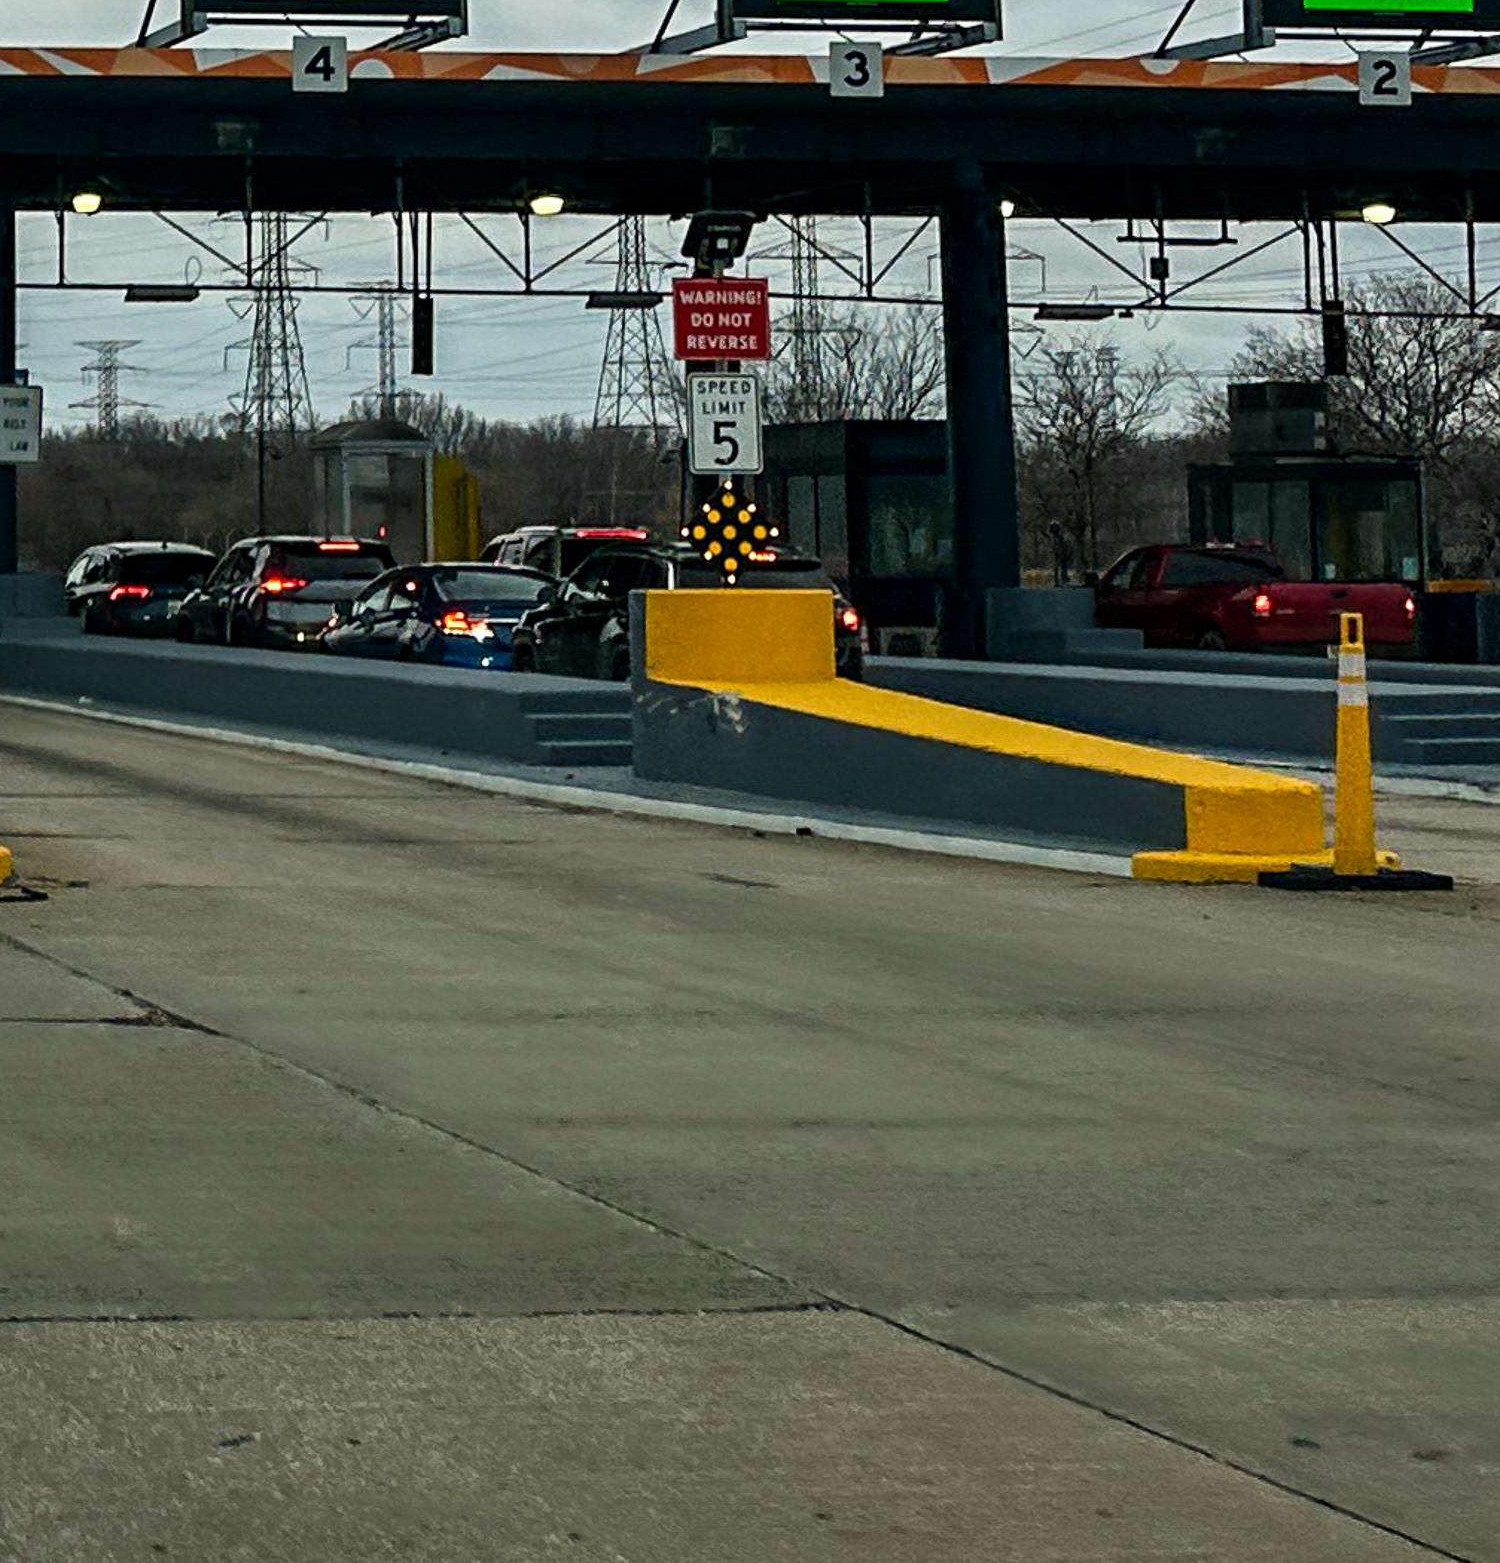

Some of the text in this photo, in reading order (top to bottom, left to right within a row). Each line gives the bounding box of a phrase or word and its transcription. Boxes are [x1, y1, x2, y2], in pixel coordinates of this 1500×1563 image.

[303, 45, 336, 82] 4
[843, 50, 870, 87] 3
[1371, 59, 1398, 96] 2
[679, 289, 762, 306] WARNING!
[690, 312, 753, 328] DO NOT
[686, 334, 758, 351] REVERSE
[696, 379, 751, 395] SPEED
[701, 401, 746, 416] LIMIT
[712, 420, 740, 467] 5
